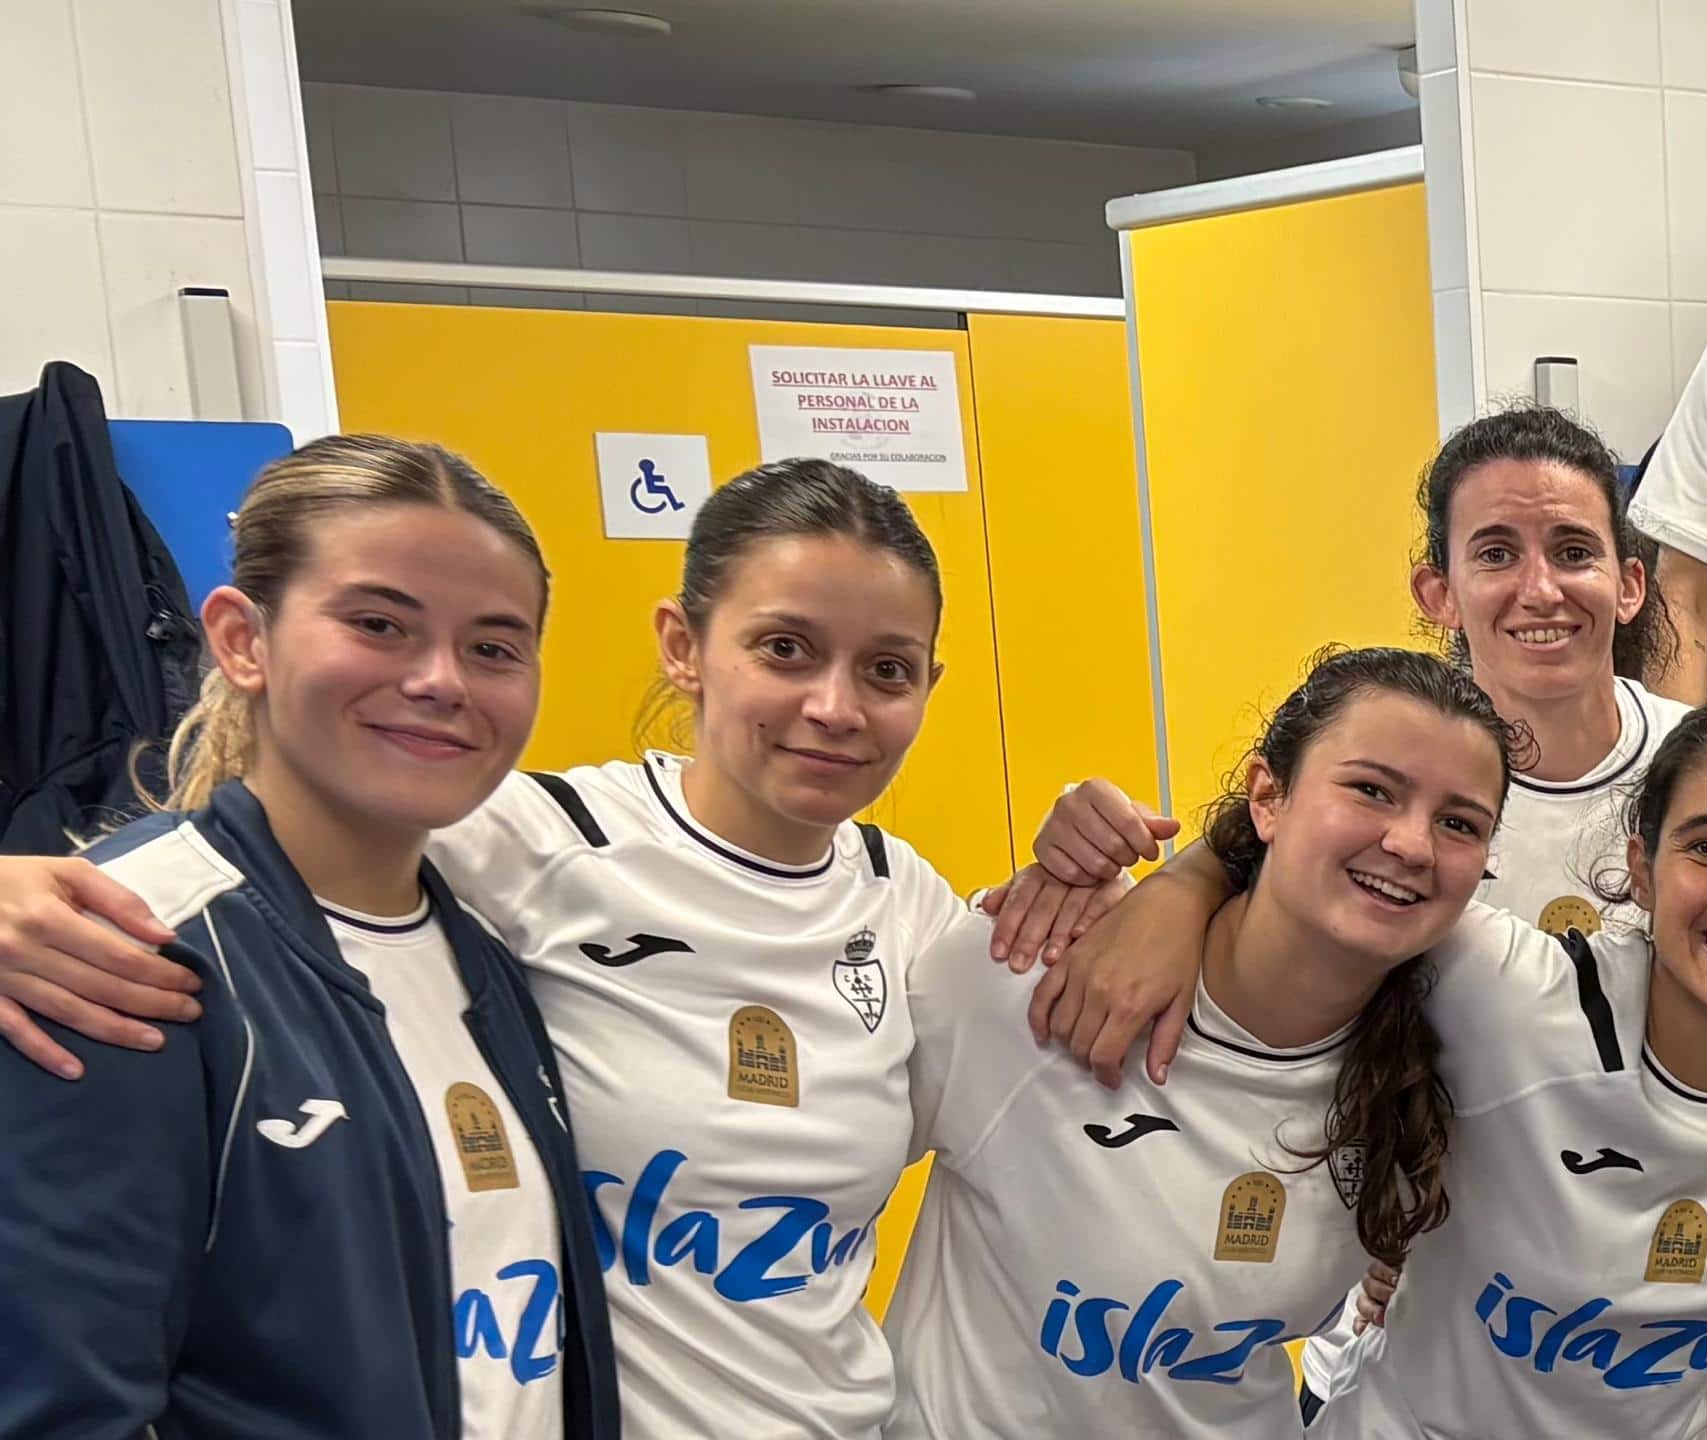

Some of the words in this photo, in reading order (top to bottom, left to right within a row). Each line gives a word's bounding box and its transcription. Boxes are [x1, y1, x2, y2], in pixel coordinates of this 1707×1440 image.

[771, 370, 848, 386] SOLICITAR
[851, 373, 870, 387] LA
[872, 374, 917, 388] LLAVE
[920, 375, 937, 388] AL
[797, 393, 875, 409] PERSONAL
[878, 396, 899, 410] DE
[901, 397, 920, 411] LA
[811, 416, 911, 432] INSTALACION
[738, 1072, 789, 1089] MADRID
[1223, 1233, 1270, 1247] MADRID
[1040, 1278, 1286, 1385] islaZ
